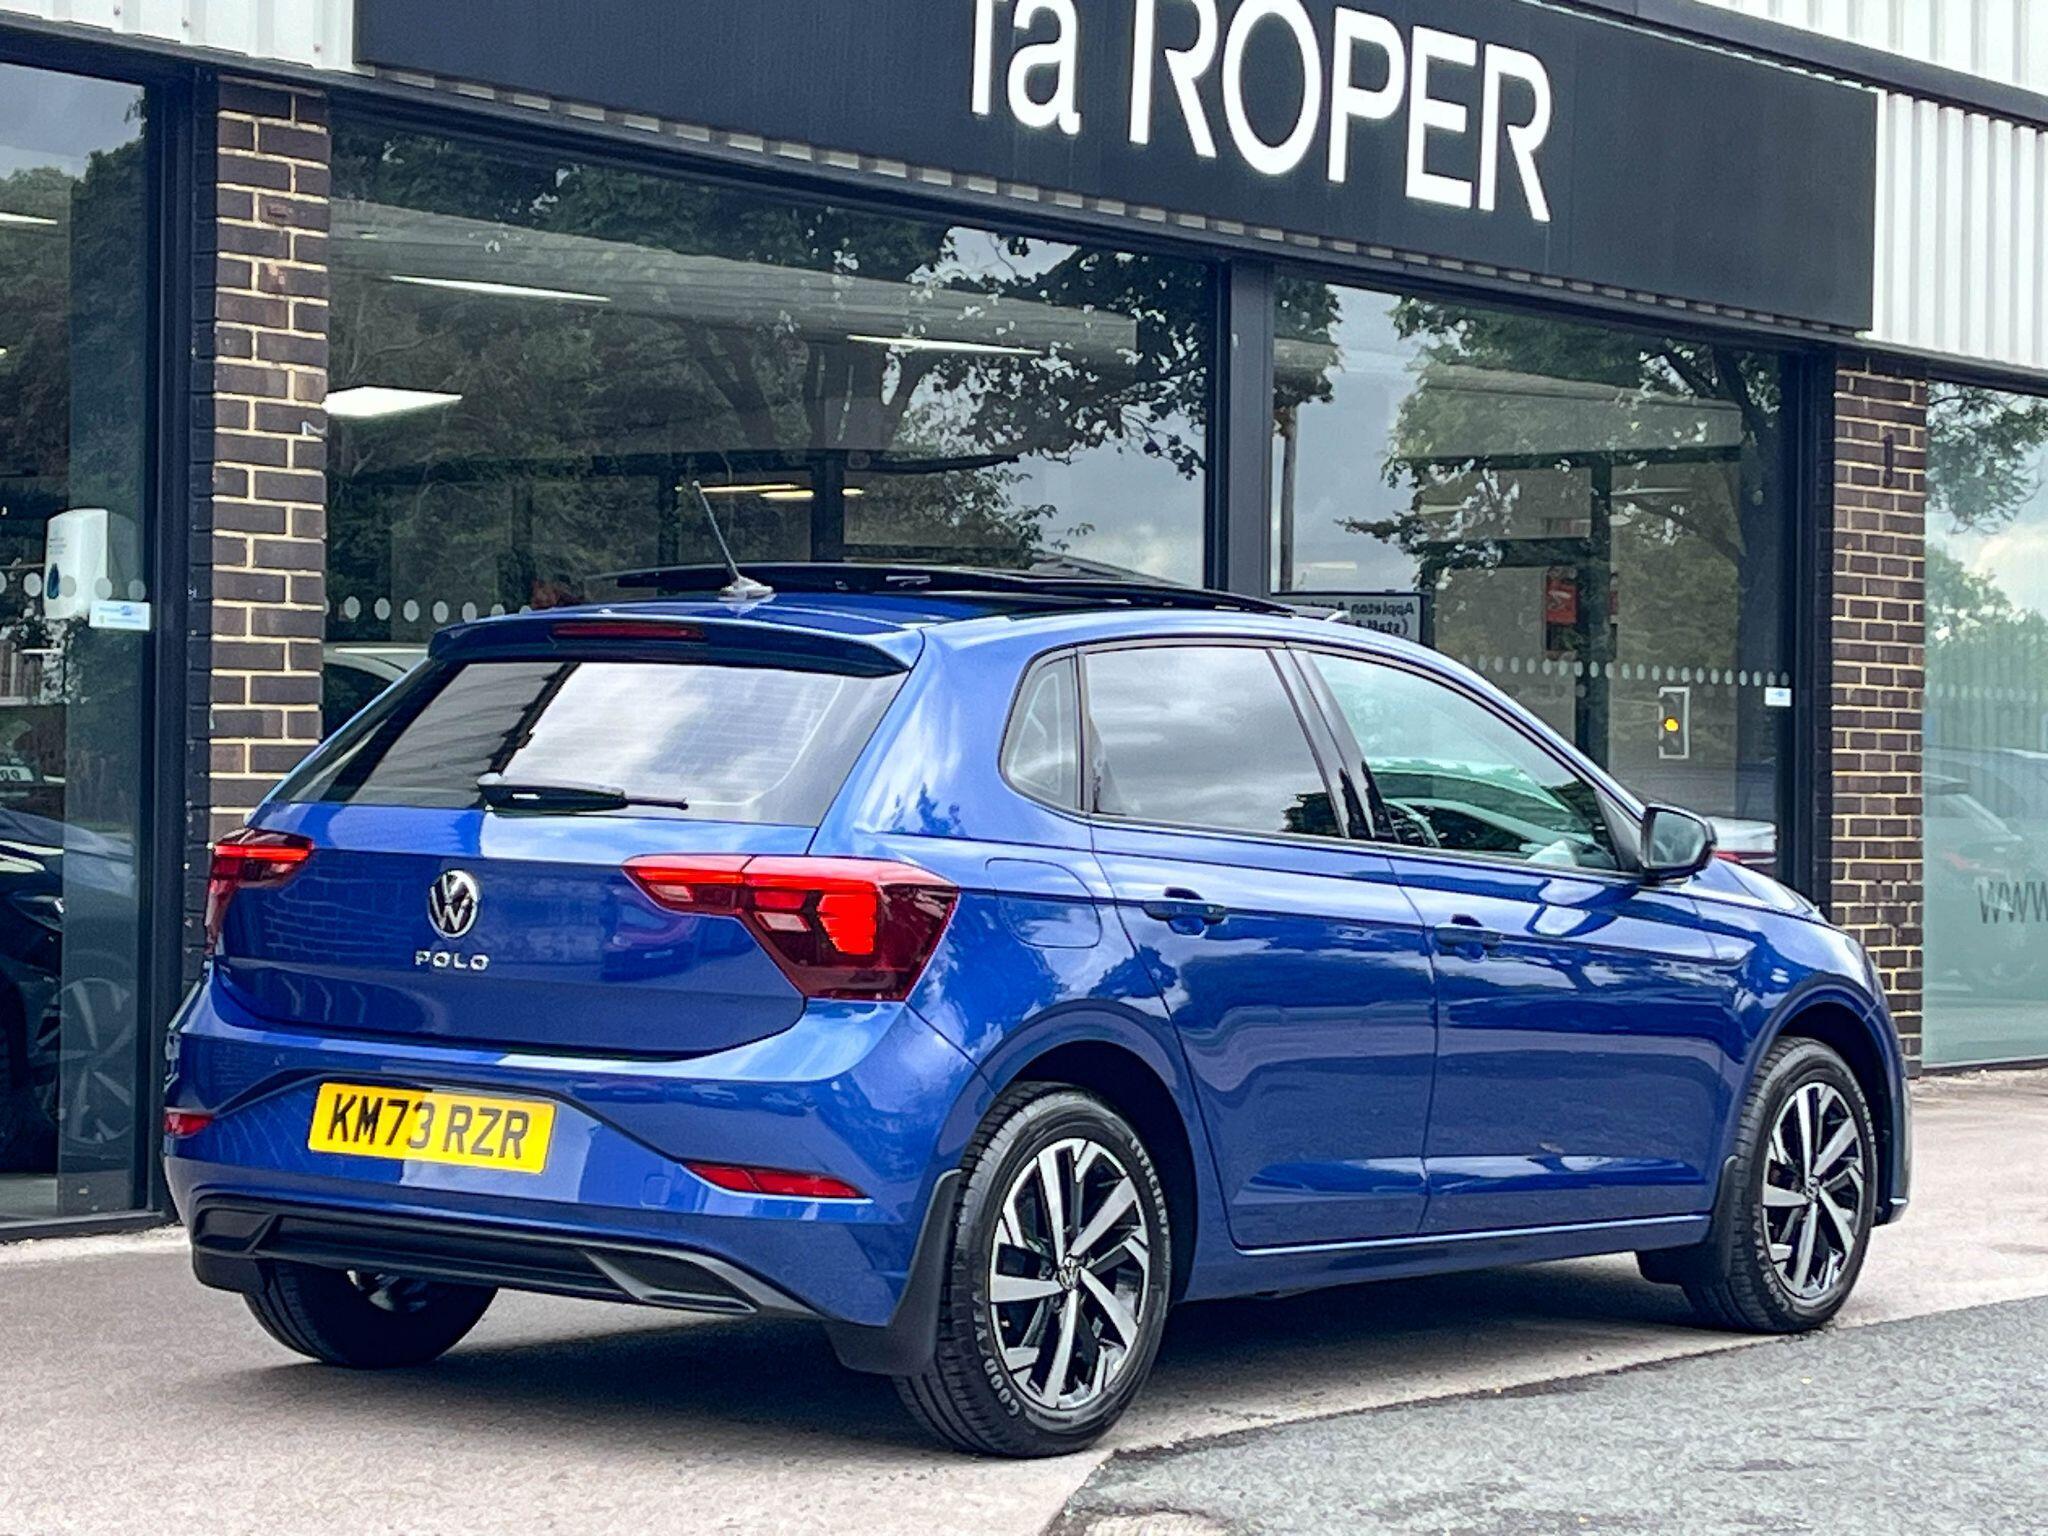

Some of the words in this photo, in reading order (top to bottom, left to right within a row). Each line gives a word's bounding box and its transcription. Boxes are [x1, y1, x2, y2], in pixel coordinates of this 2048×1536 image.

[1128, 0, 1552, 223] ROPER
[414, 950, 490, 971] POLO
[327, 1093, 436, 1149] KM73
[442, 1104, 530, 1160] RZR
